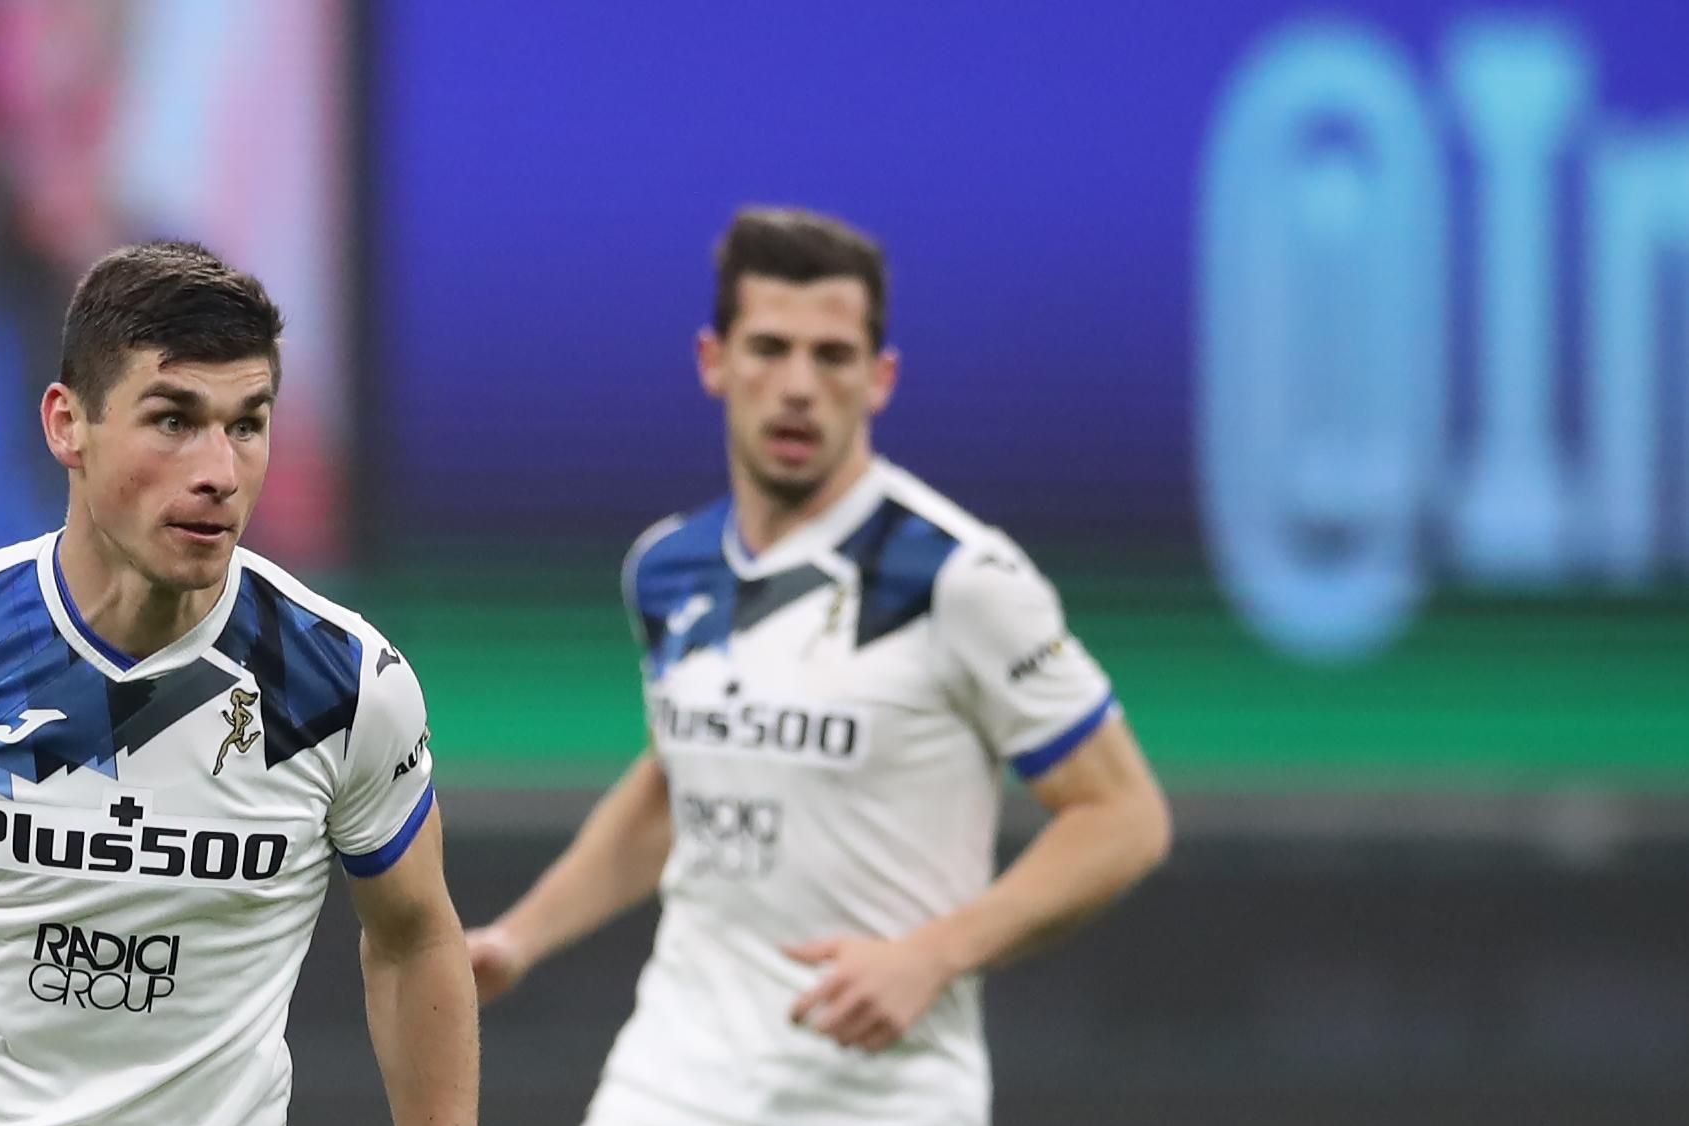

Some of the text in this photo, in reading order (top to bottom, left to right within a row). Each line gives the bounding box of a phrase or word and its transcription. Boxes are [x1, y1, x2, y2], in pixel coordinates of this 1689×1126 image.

[657, 695, 857, 757] lus500
[33, 922, 180, 976] RADICI
[29, 962, 175, 1013] GROUP
